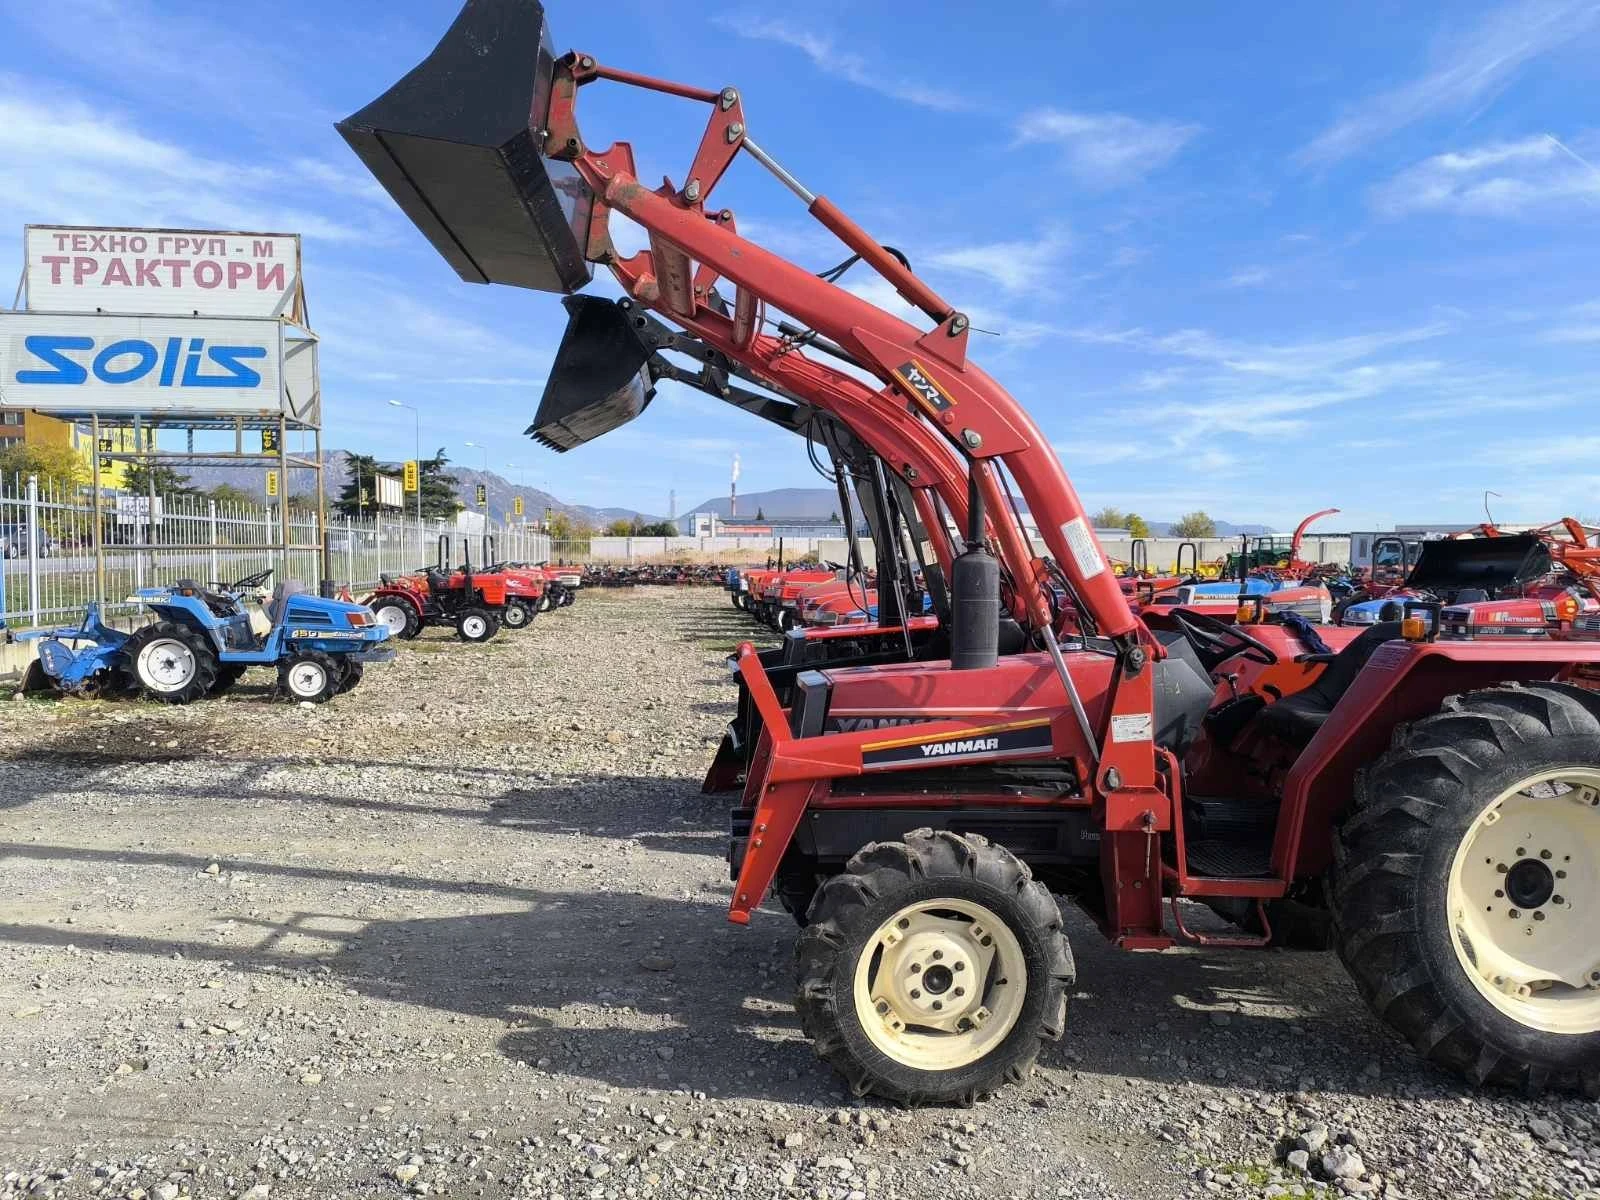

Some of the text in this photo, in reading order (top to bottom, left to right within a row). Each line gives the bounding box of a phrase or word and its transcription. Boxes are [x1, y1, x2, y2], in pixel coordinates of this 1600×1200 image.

[53, 234, 147, 253] ТЕХНО
[158, 237, 226, 256] ГРУП
[253, 240, 273, 257] М
[42, 256, 285, 291] ТРАКТОРИ
[407, 463, 415, 489] EFBET
[920, 738, 999, 756] YANMAR
